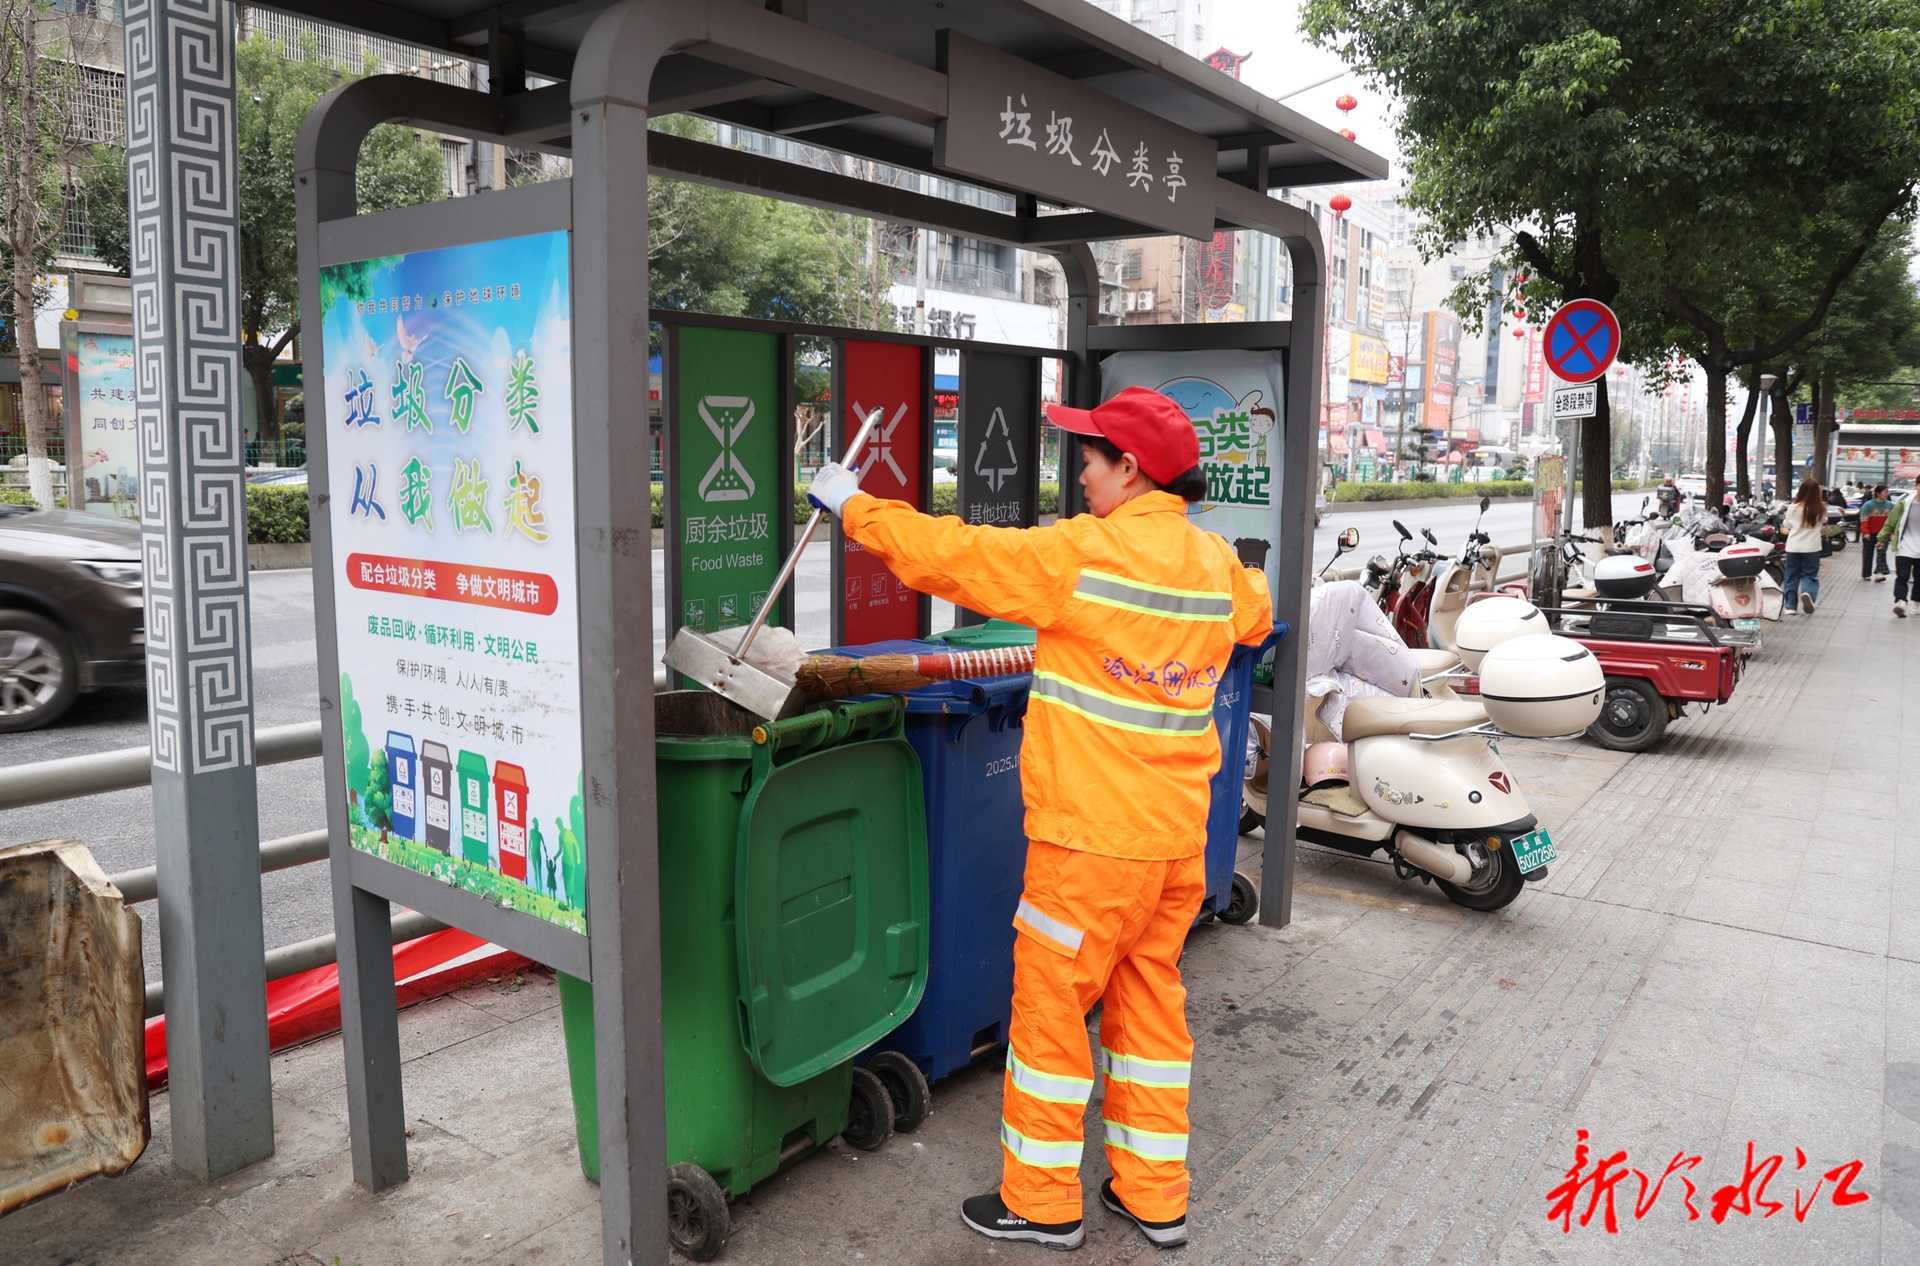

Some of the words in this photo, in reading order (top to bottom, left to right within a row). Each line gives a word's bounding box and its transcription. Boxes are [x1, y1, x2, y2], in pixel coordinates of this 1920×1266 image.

[999, 93, 1187, 203] 垃圾分类亭
[357, 295, 423, 315] 你我共同努力
[442, 283, 521, 307] 保护地球环境
[107, 346, 134, 357] 讲文
[344, 356, 540, 435] 垃圾分类
[1555, 391, 1594, 413] 全路段禁停
[351, 457, 549, 542] 从我做起
[969, 501, 1020, 525] 其他垃圾
[685, 513, 769, 544] 厨余垃圾
[692, 556, 723, 572] Food
[726, 552, 764, 568] Waste
[360, 561, 437, 591] 配合垃圾分类
[456, 572, 540, 605] 争做文明城市
[1518, 843, 1556, 870] 5027258
[997, 1218, 1027, 1226] sports
